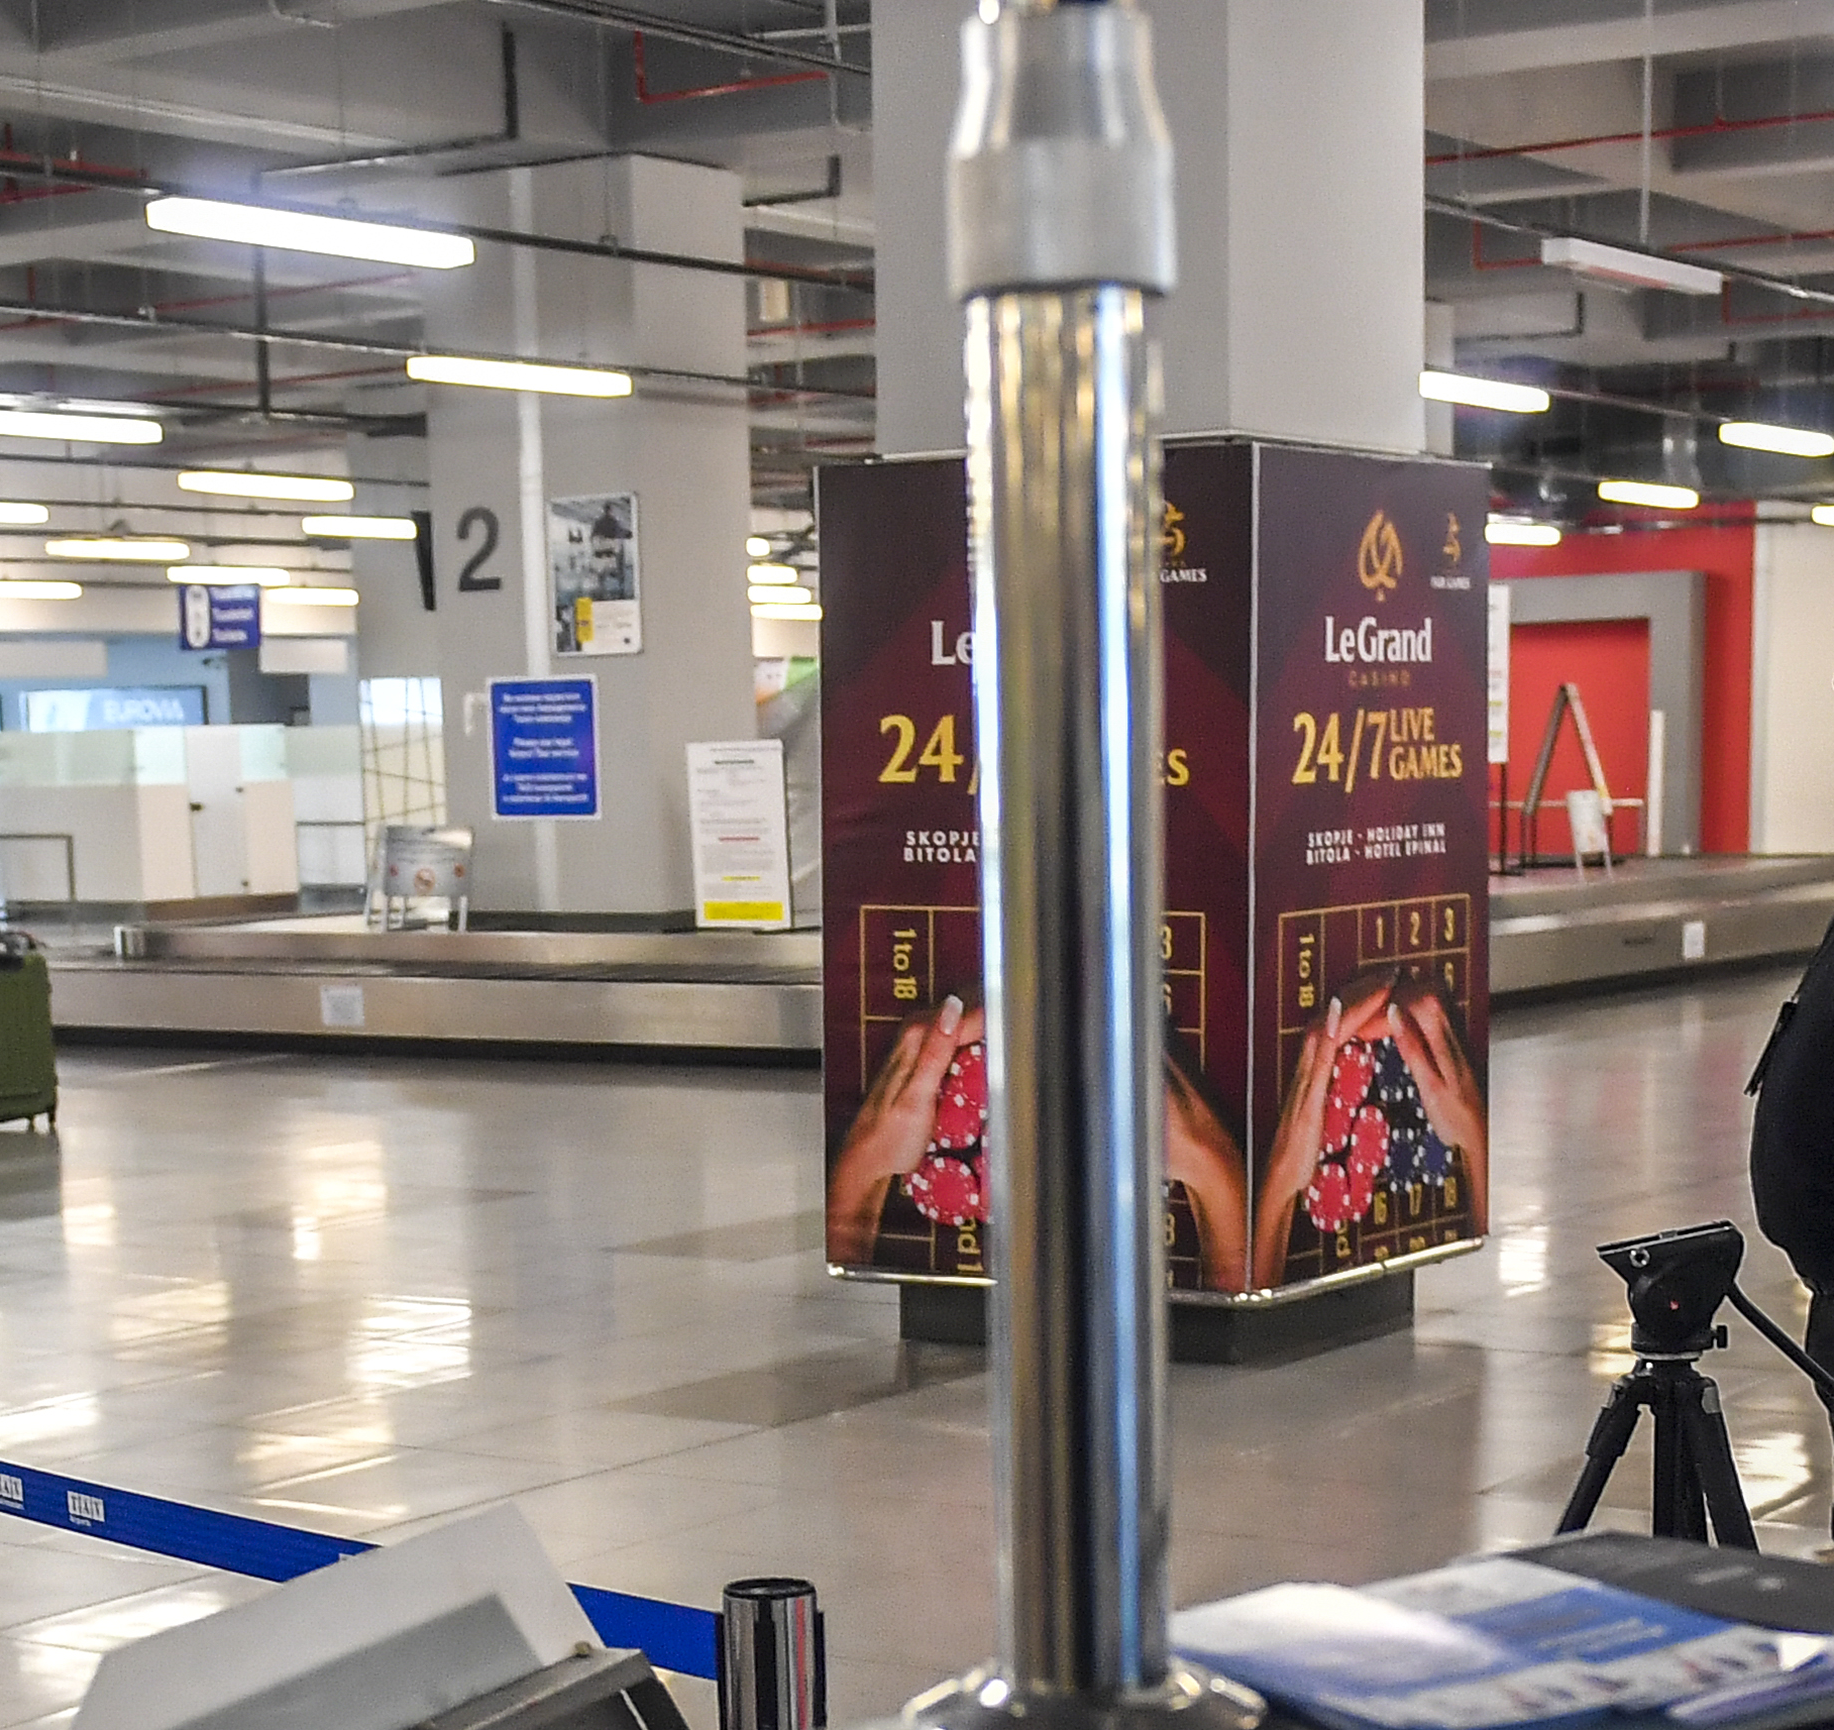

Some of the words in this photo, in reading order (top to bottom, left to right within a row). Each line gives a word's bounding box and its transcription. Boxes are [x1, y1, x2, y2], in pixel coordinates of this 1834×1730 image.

[457, 506, 501, 592] 2
[1349, 670, 1411, 688] CASINO
[1390, 707, 1435, 743] LIVE
[1292, 708, 1388, 794] 24/7
[1388, 742, 1464, 781] GAMES
[1308, 828, 1354, 848] SKOPJE
[1367, 824, 1419, 842] HOLIDAY
[1422, 822, 1446, 838] INN
[903, 847, 977, 864] BITOLA
[1305, 848, 1351, 866] BITOLA
[1364, 843, 1402, 860] HOTEL
[1376, 915, 1385, 950] 1
[1409, 911, 1421, 947] 2
[1443, 907, 1455, 942] 3
